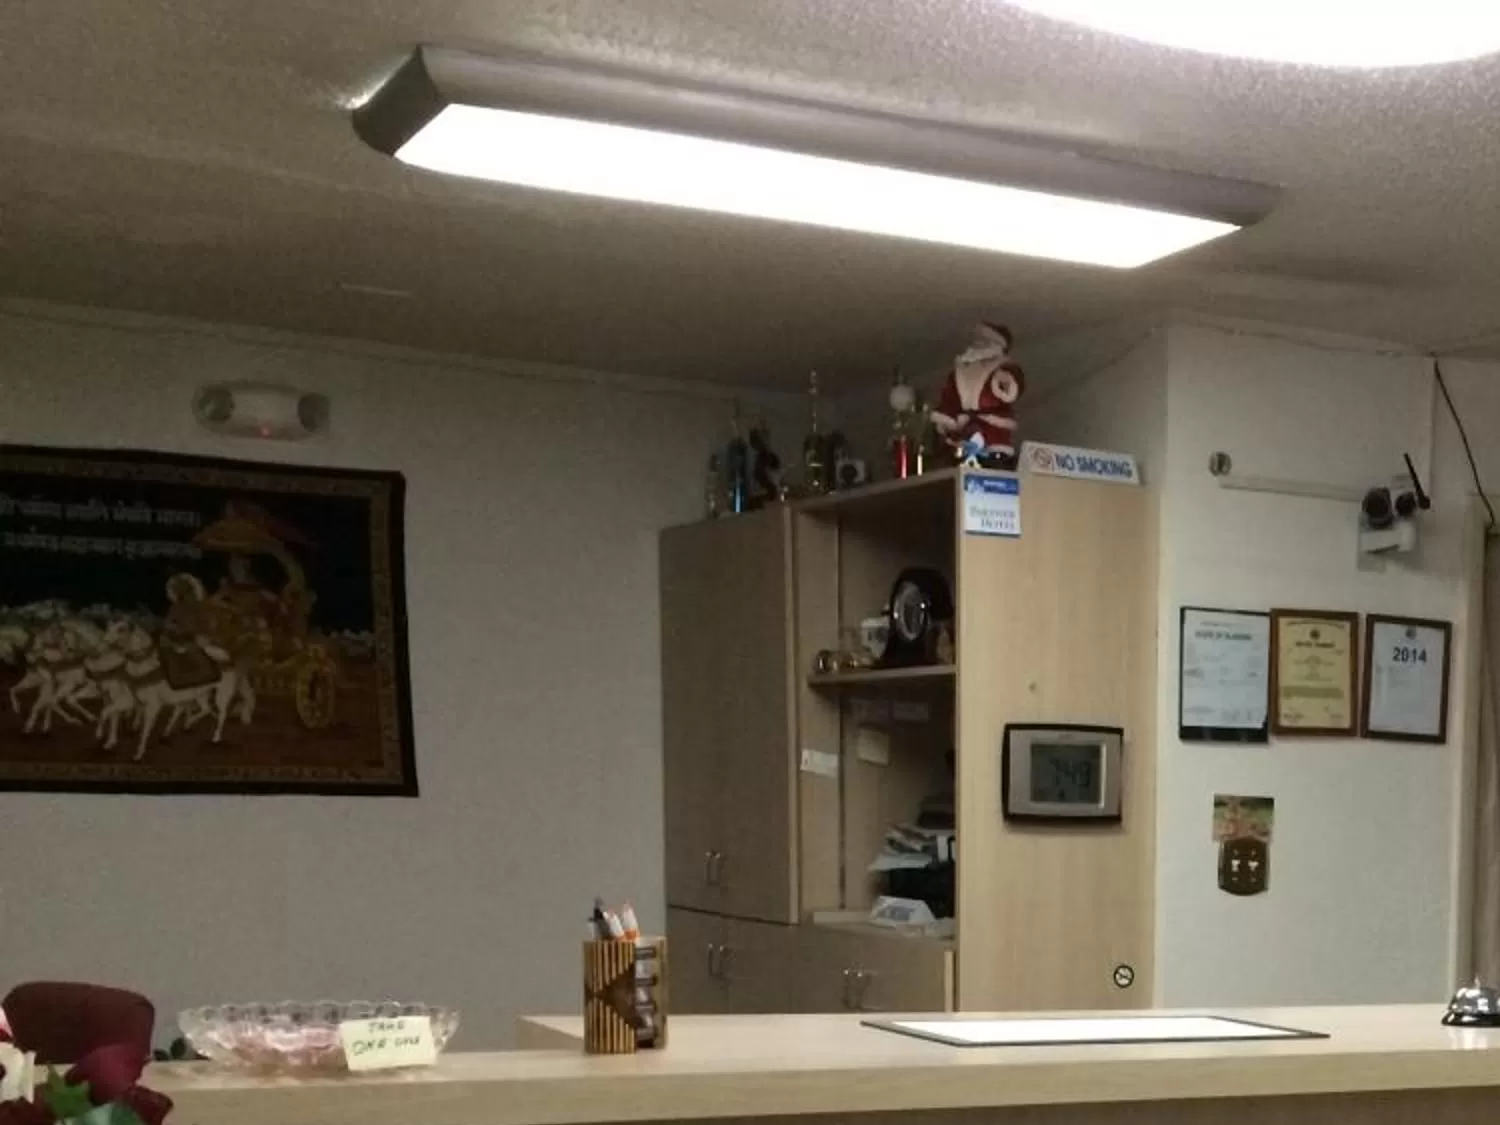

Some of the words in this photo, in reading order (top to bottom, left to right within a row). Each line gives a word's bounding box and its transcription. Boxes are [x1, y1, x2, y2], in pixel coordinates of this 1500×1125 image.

[1055, 453, 1076, 471] NO
[1076, 455, 1133, 478] SMOKING
[1392, 645, 1428, 664] 2014
